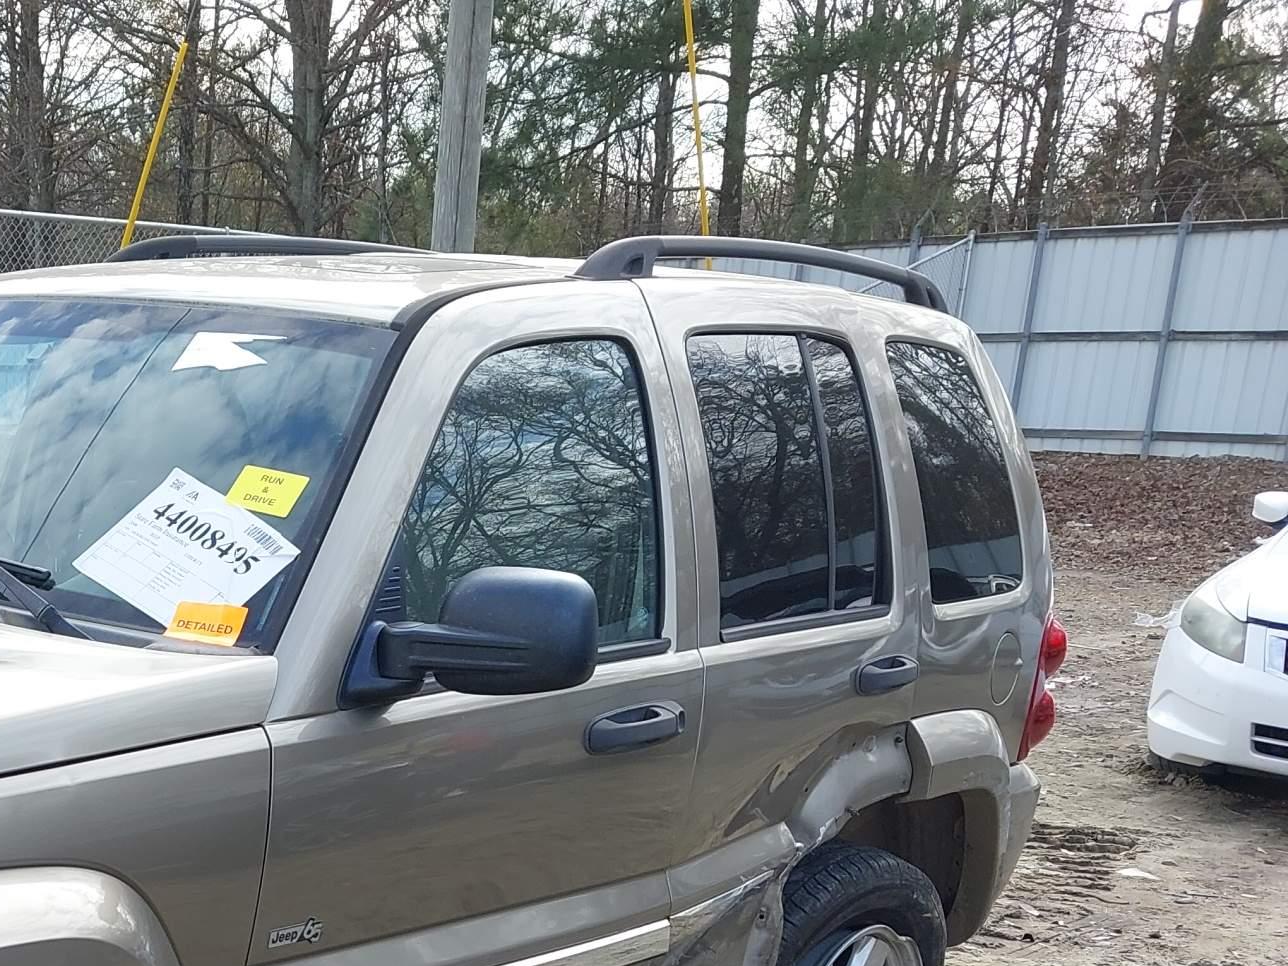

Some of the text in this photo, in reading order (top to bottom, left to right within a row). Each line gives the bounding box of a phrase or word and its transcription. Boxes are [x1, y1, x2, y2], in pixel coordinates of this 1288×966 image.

[261, 474, 285, 486] RUN
[243, 492, 277, 506] DRIVE
[153, 503, 261, 575] 44008495
[176, 618, 233, 635] DETAILED
[272, 930, 298, 944] Jeep
